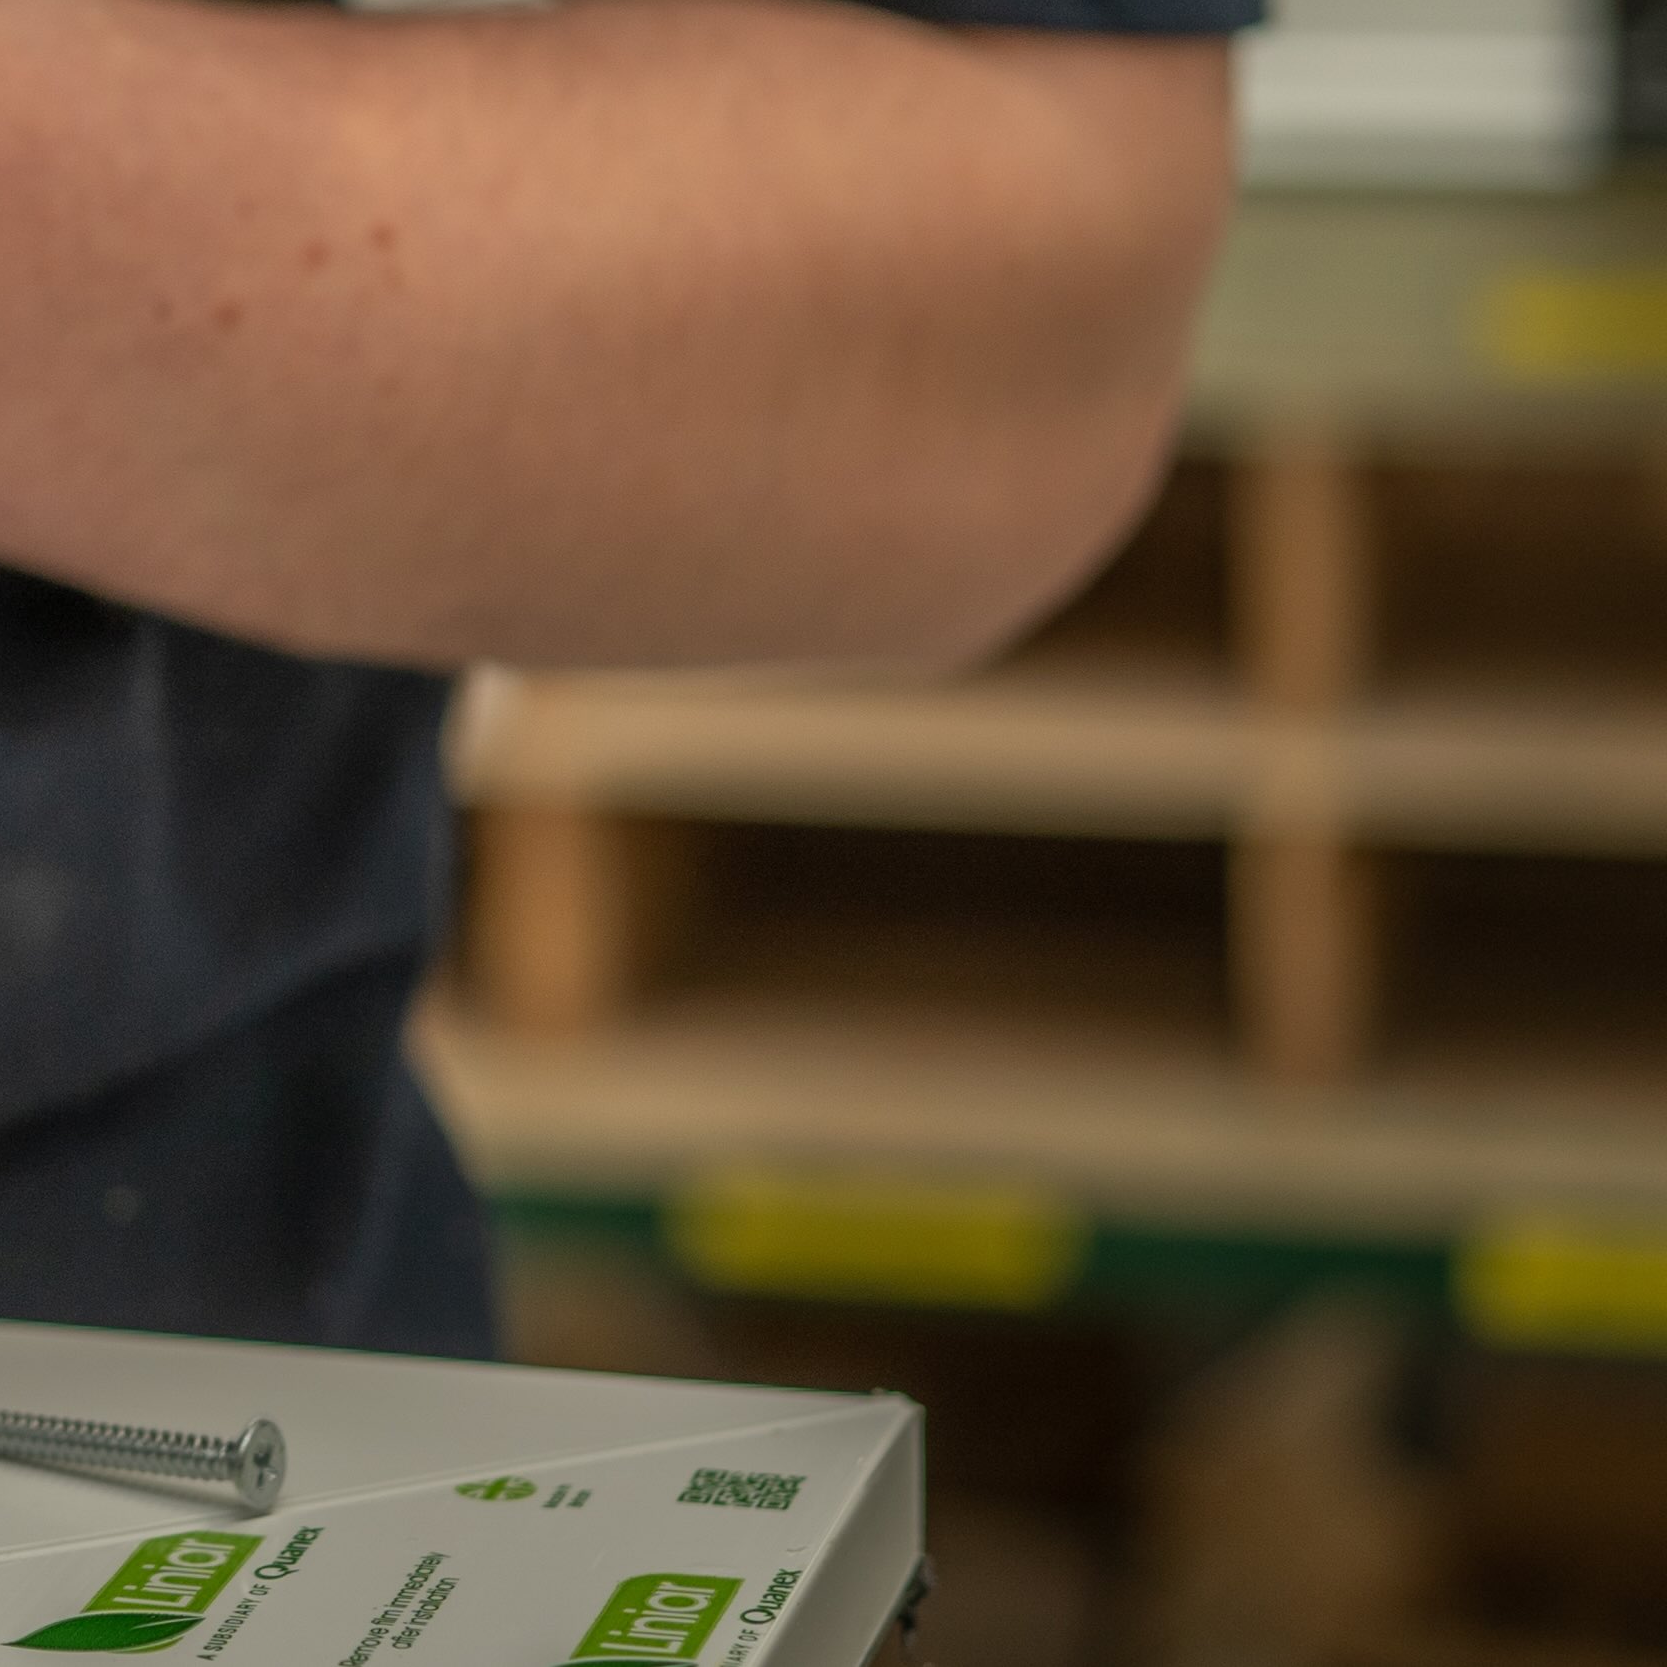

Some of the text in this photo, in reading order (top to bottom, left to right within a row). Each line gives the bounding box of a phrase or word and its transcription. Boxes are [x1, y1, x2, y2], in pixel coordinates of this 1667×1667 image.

[113, 1538, 235, 1609] Liniar
[196, 1526, 326, 1662] A SUBSIDIARY OF Quanex
[383, 1551, 451, 1609] immediately
[403, 1577, 460, 1626] installation
[740, 1568, 803, 1625] Quanex
[371, 1609, 404, 1626] film
[599, 1581, 716, 1654] Liniar
[738, 1629, 760, 1642] OF
